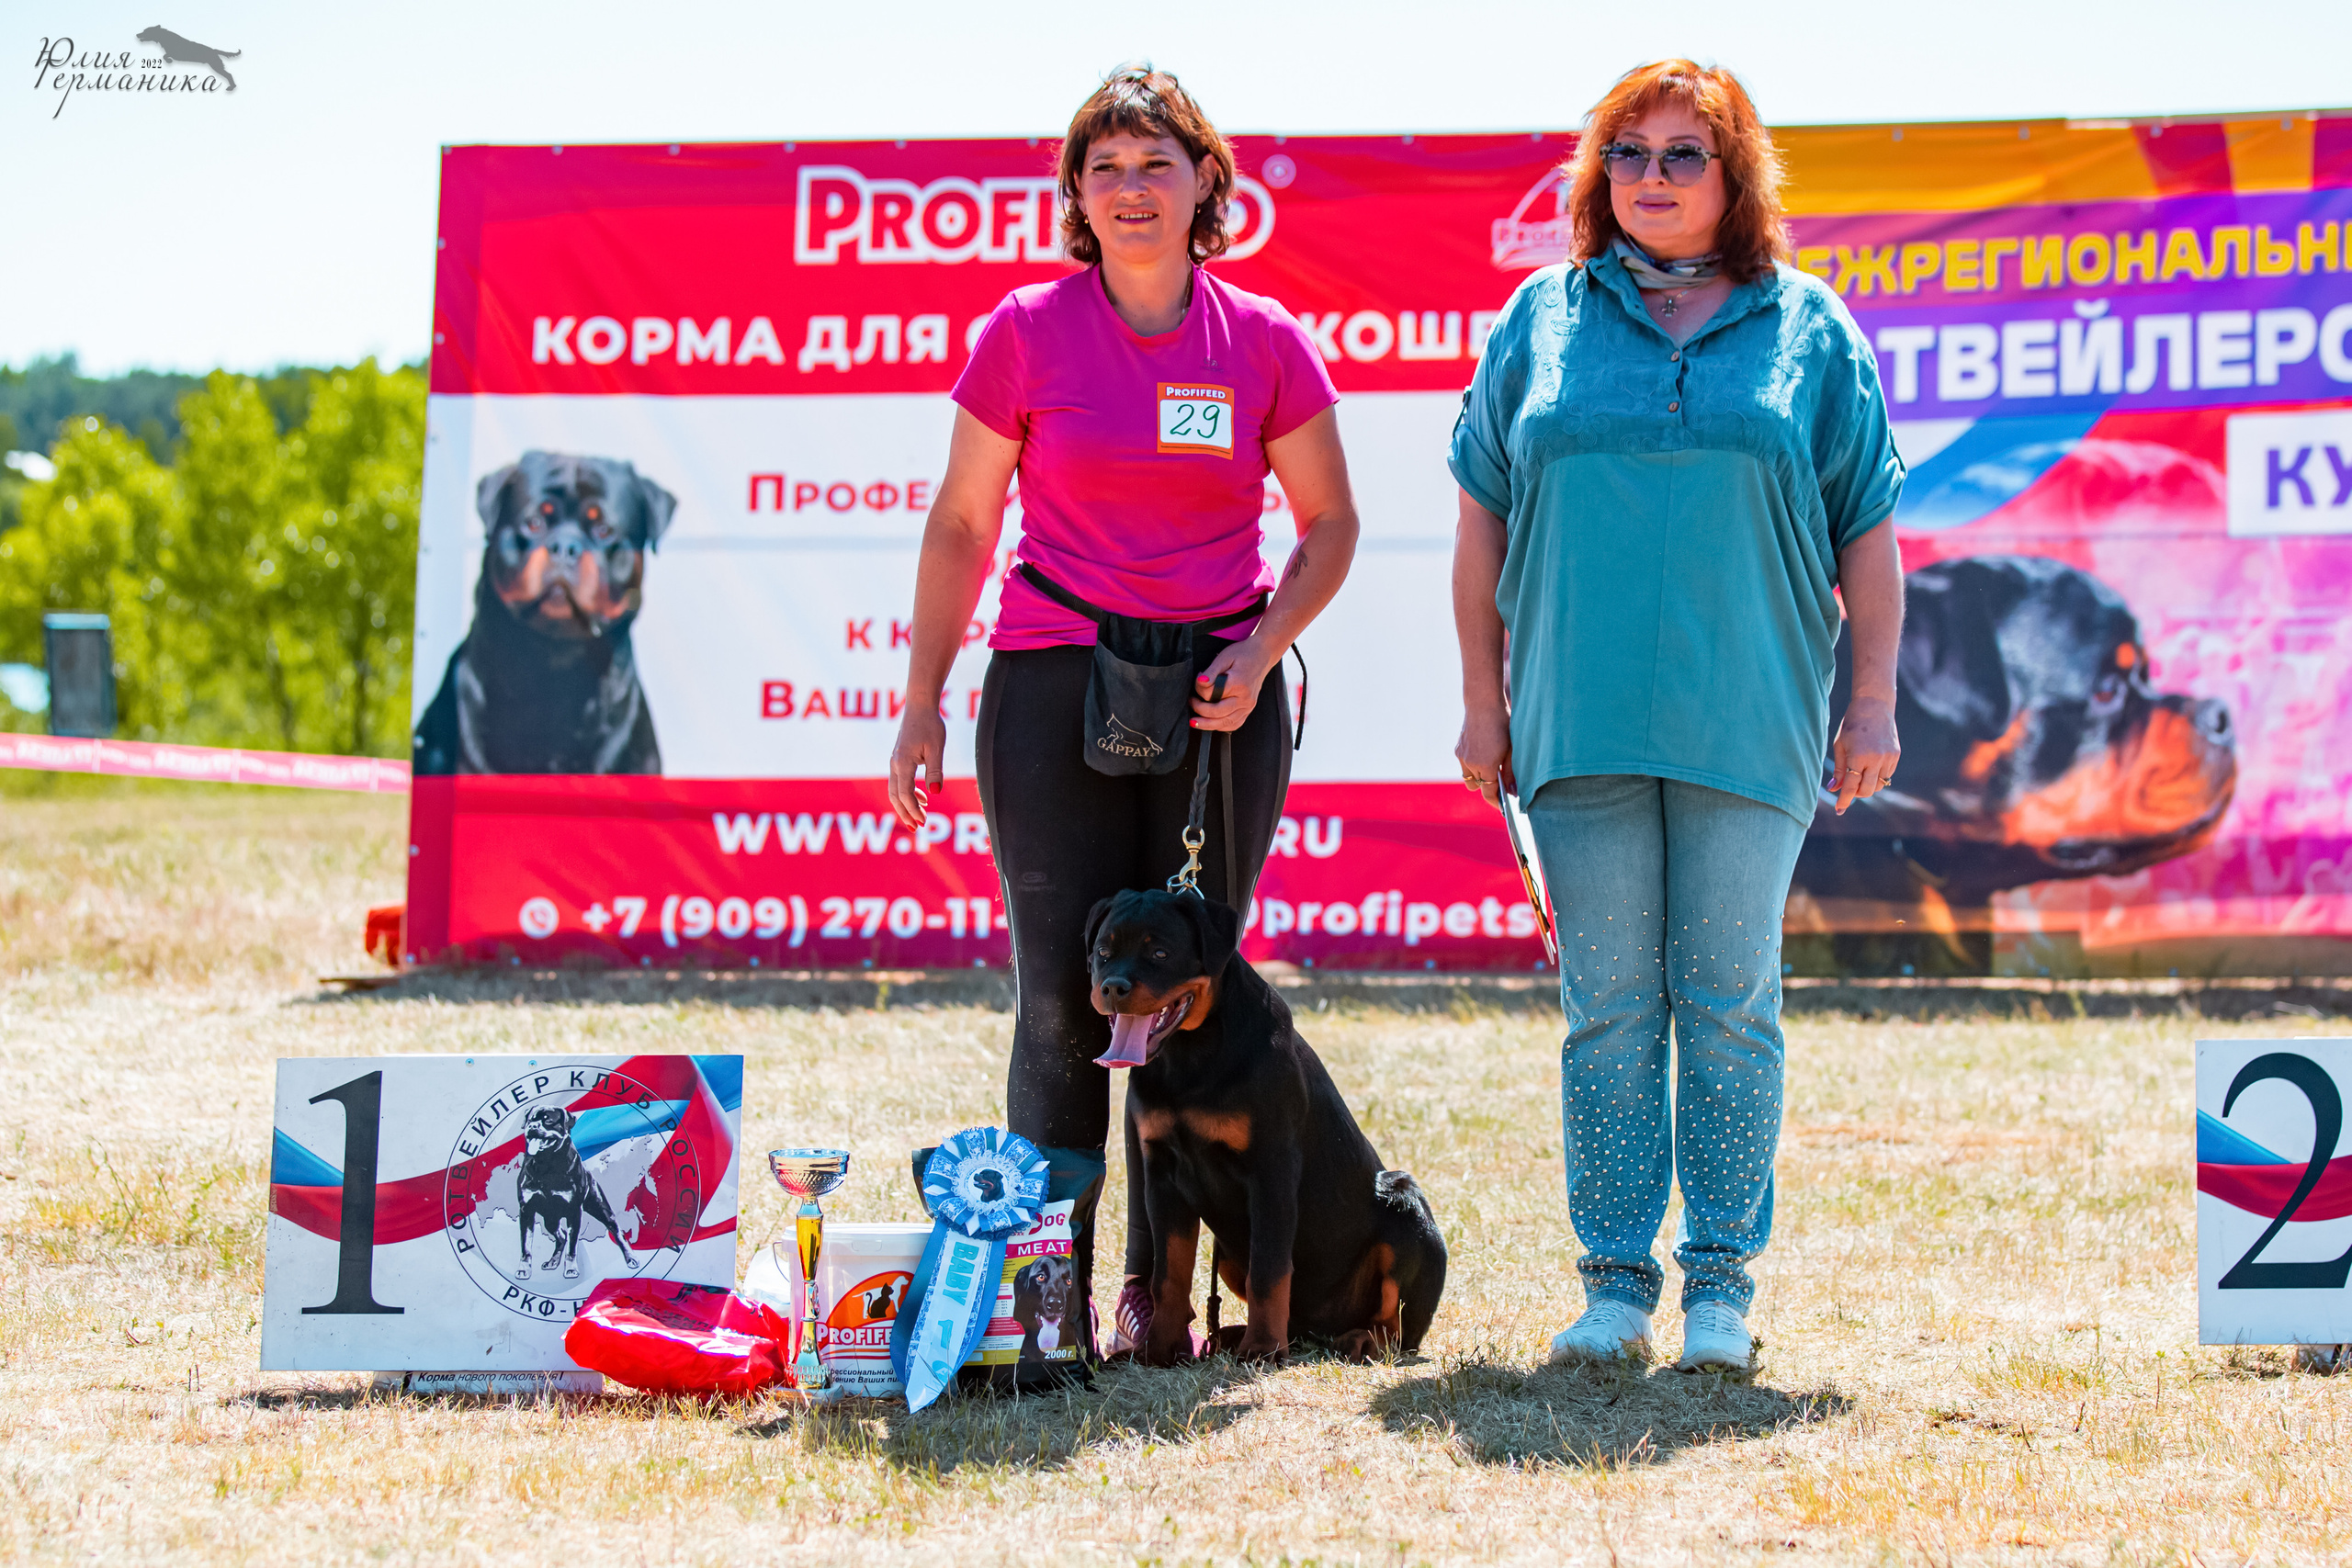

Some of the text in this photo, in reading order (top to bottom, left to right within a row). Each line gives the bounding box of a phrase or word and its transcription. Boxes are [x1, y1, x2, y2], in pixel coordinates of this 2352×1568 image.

[795, 165, 1276, 265] PROFID
[532, 314, 786, 366] КОРМА
[797, 313, 950, 372] ДЛЯ
[1165, 386, 1227, 400] PROFIFEED
[1170, 404, 1220, 439] 29
[1097, 737, 1151, 758] GAPPAY
[582, 895, 1010, 947] +7 (909) 270-11-
[448, 1071, 696, 1255] РОТВЕЙЛЕР КЛУБ РОССИИ
[2217, 1052, 2352, 1290] 2
[301, 1070, 404, 1314] 1
[1017, 1242, 1067, 1256] MEAT
[942, 1241, 979, 1306] BABY
[503, 1285, 586, 1317] РКФ-Н
[816, 1321, 892, 1346] PROFIFE
[1044, 1349, 1067, 1359] 2000
[417, 1371, 456, 1383] Корма
[458, 1371, 496, 1382] нового
